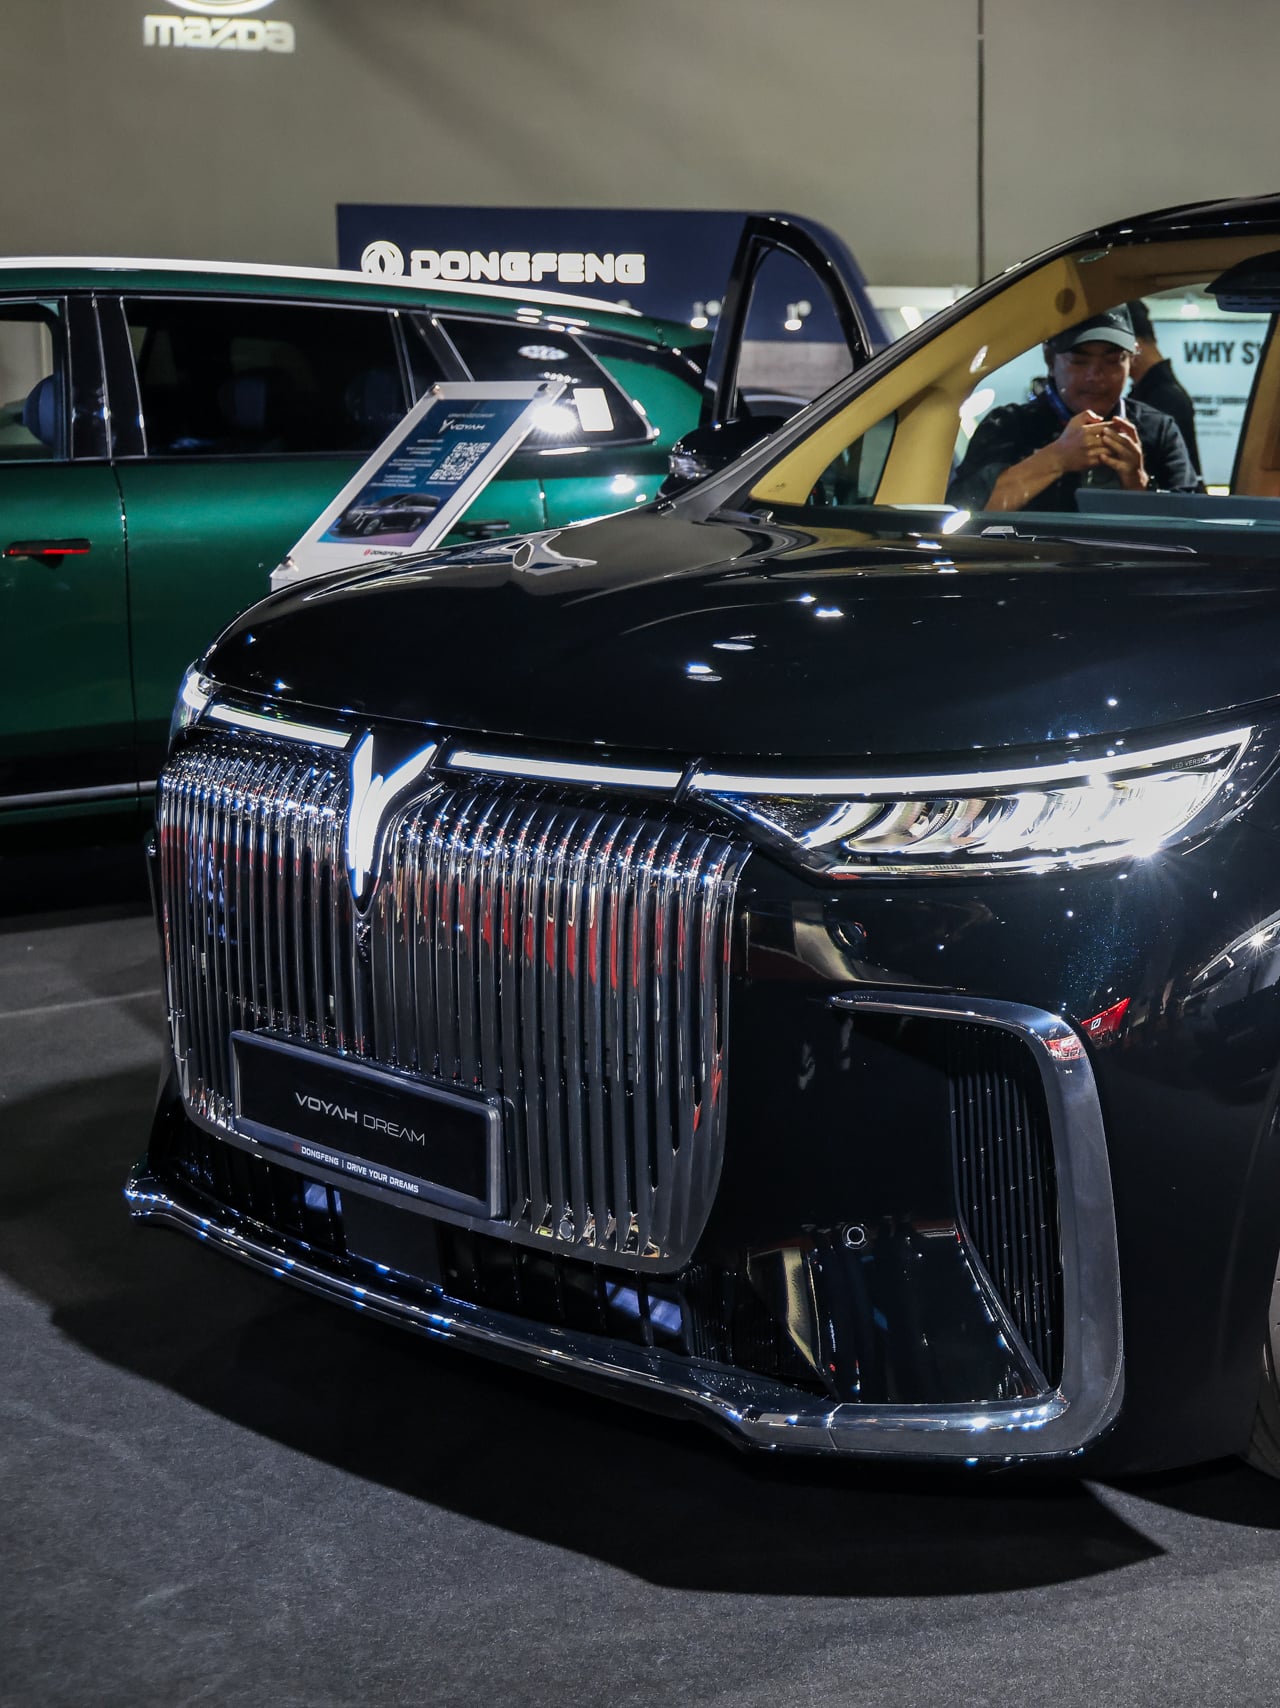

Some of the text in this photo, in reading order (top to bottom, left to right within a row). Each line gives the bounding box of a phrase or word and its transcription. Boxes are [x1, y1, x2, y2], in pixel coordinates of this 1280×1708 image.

[410, 250, 645, 284] DONGFENG
[1184, 341, 1235, 363] WHY
[295, 1092, 426, 1146] VOYAH DREAM
[301, 1146, 419, 1194] DONGFENG DRIVE YOUR DREAMS
